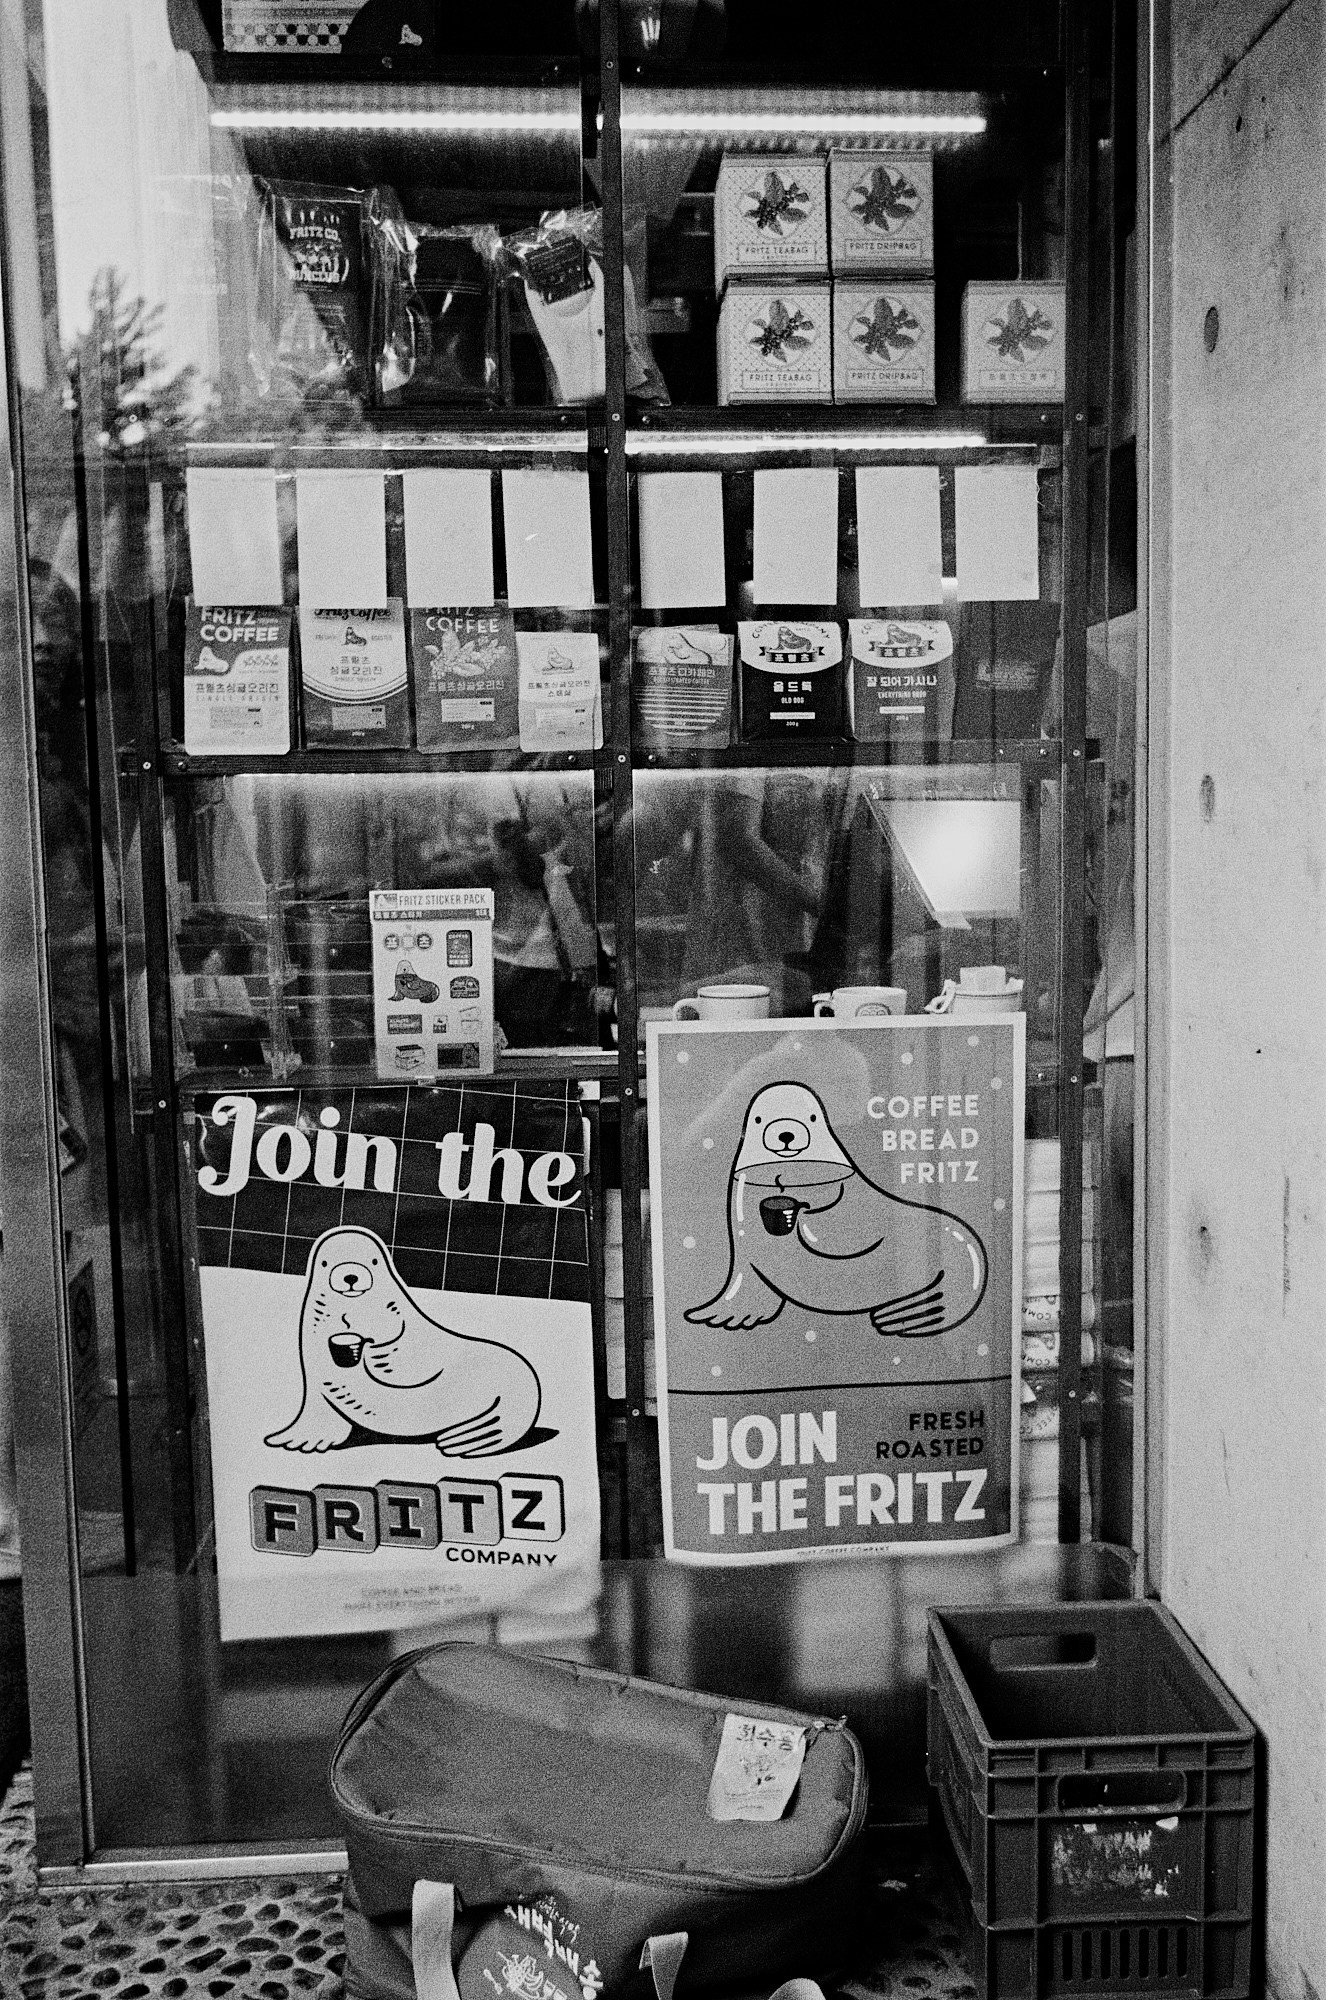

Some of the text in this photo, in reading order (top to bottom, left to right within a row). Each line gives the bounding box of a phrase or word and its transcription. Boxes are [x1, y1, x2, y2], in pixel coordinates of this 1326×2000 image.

[201, 606, 256, 625] FRITZ
[426, 616, 499, 633] COFFEE
[200, 624, 280, 643] COFFEE
[399, 893, 486, 906] FRITZ STICKER PACK
[867, 1094, 979, 1119] COFFEE
[882, 1127, 979, 1151] BREAD
[197, 1095, 582, 1208] Join the
[900, 1160, 979, 1184] FRITZ
[909, 1410, 985, 1431] FRESH
[696, 1410, 838, 1471] JOIN
[876, 1437, 984, 1459] ROASTED
[697, 1469, 988, 1534] THE FRITZ
[264, 1489, 546, 1543] FRITZ
[446, 1548, 558, 1567] COMPANY
